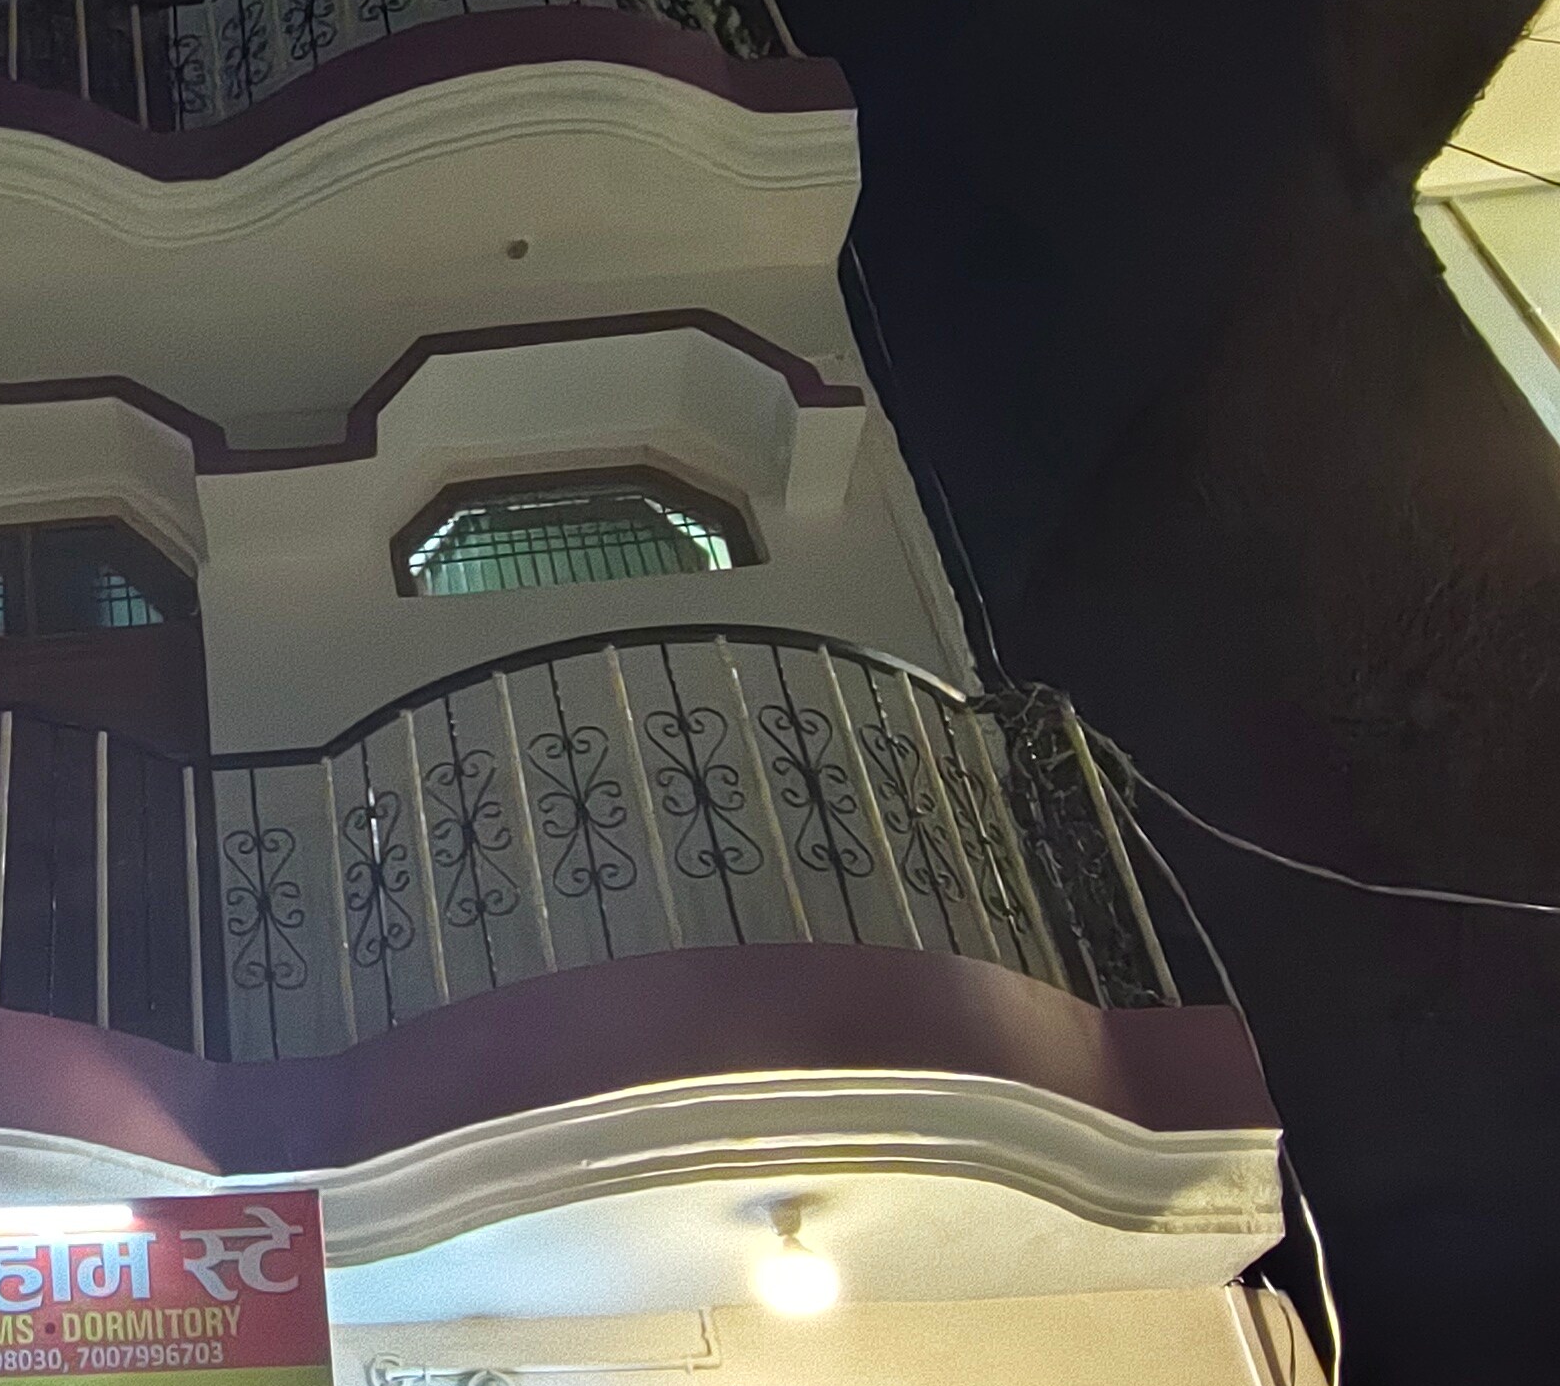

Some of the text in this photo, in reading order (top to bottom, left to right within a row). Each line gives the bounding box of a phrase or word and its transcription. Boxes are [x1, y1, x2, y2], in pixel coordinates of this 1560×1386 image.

[181, 1206, 303, 1302] स्टे
[62, 1305, 240, 1343] DORMITORY
[77, 1341, 224, 1369] 7007996703
